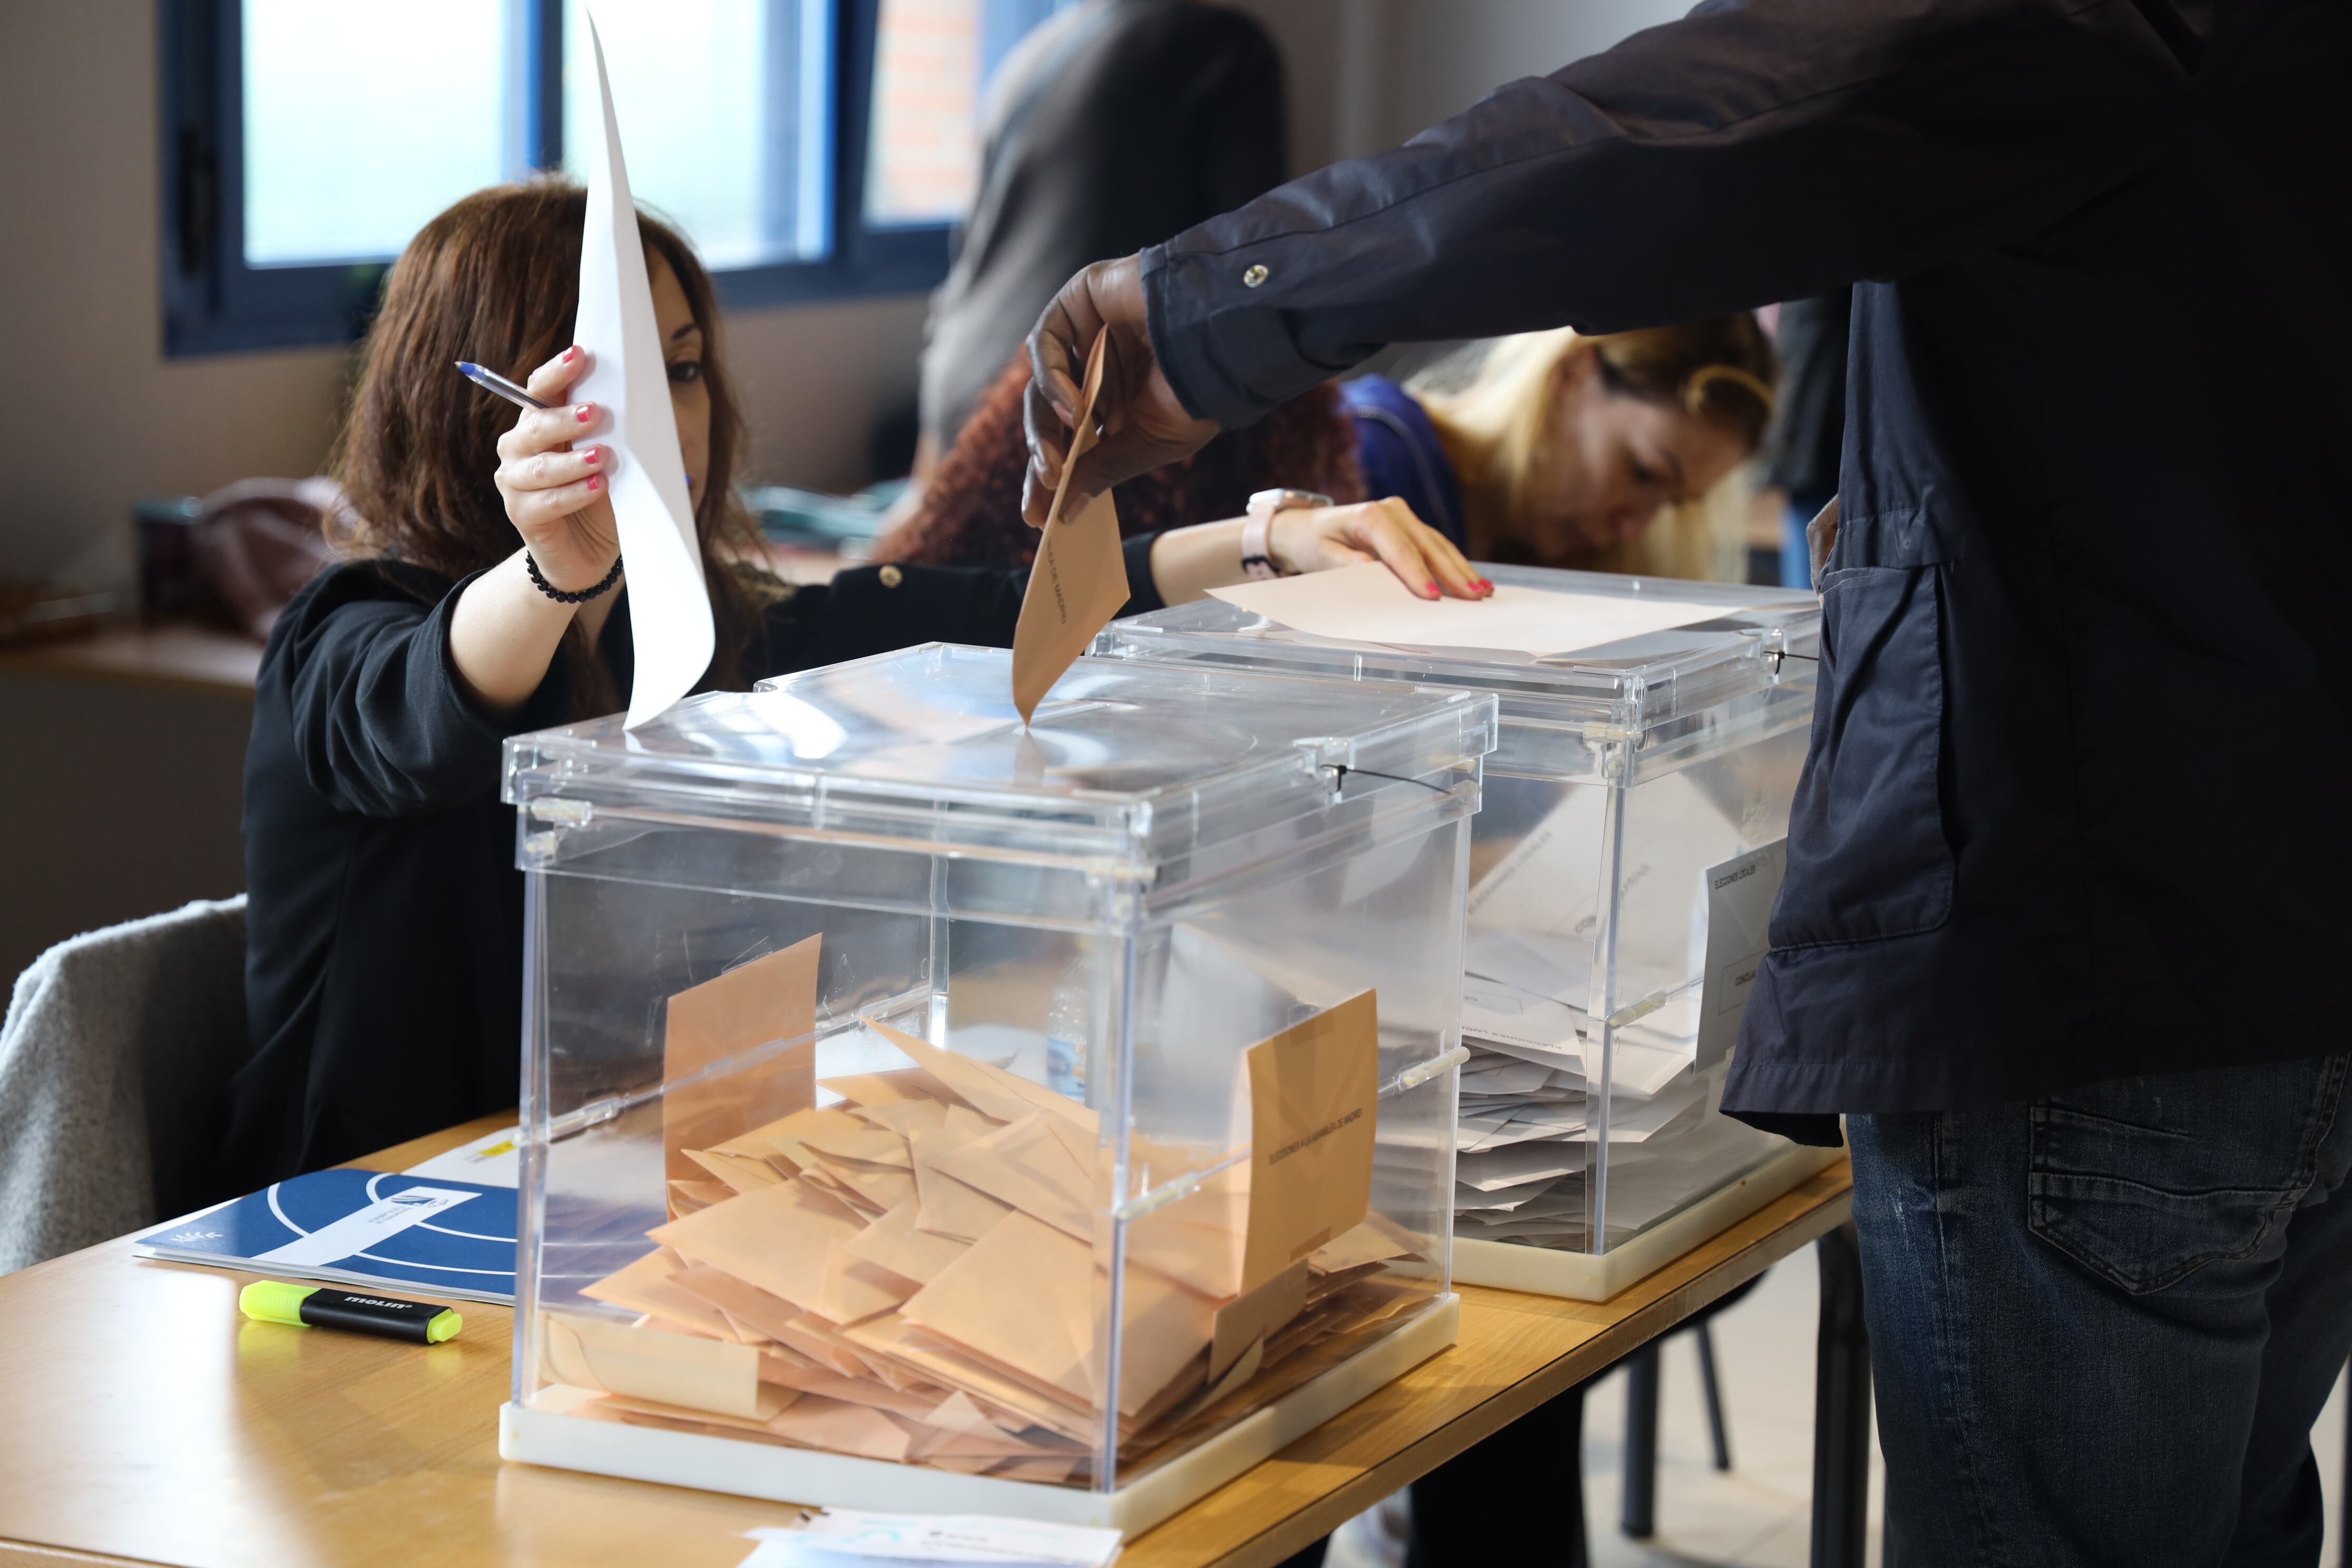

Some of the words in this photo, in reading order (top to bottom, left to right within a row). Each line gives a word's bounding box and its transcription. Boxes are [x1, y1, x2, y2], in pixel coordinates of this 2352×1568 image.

[1054, 583, 1067, 624] MADRID
[1714, 871, 1738, 890] ELECCIONES
[1739, 864, 1756, 879] LOCALES
[1492, 1032, 1562, 1050] ELECCIONES
[1344, 1107, 1362, 1127] MADRID
